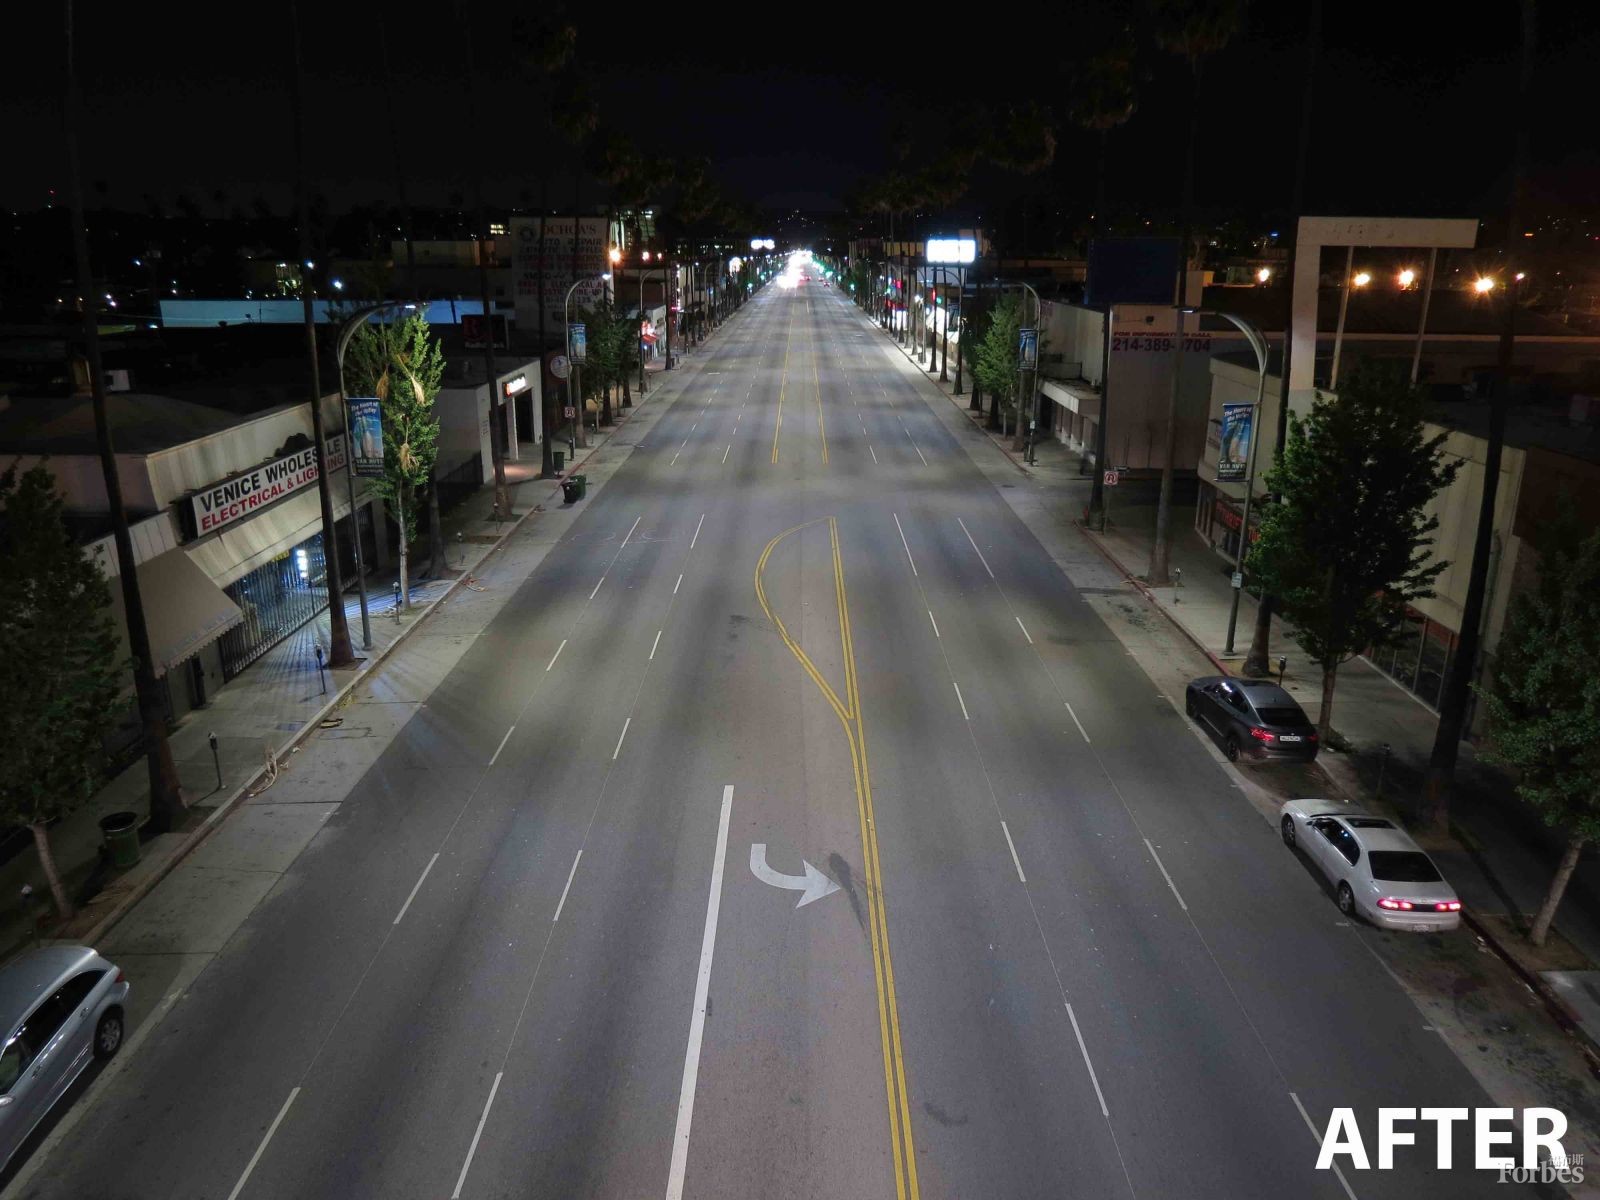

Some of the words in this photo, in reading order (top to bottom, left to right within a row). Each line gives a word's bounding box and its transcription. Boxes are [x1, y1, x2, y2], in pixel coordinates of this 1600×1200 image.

[1113, 338, 1210, 352] 214-389-704
[200, 473, 260, 512] VENICE
[265, 438, 341, 483] WHOLESLE
[202, 482, 285, 530] ELECTRICAL
[287, 477, 294, 490] &
[297, 453, 344, 485] LIGHING
